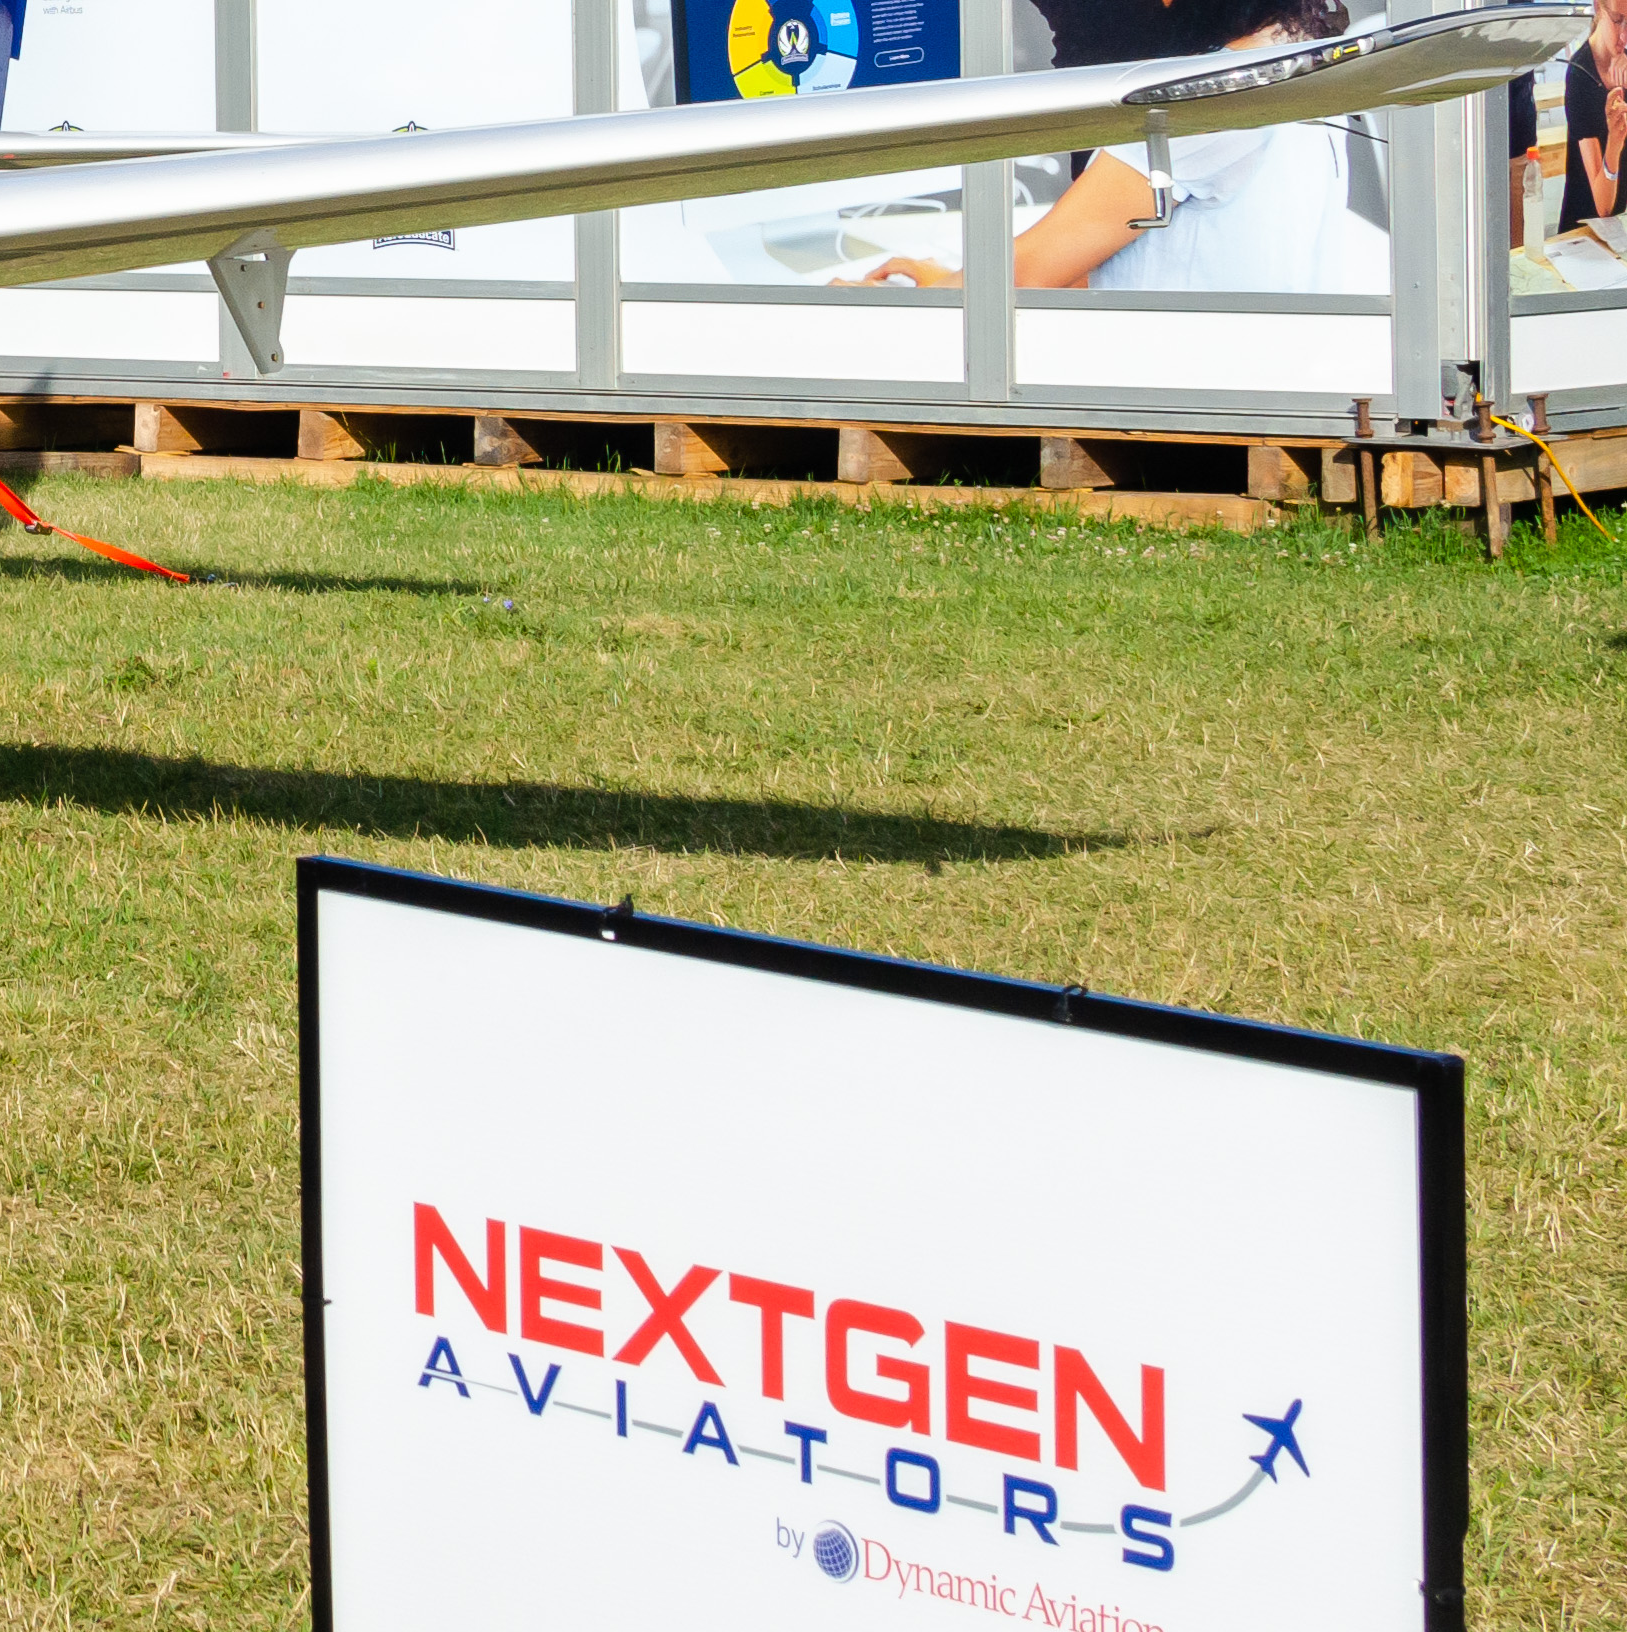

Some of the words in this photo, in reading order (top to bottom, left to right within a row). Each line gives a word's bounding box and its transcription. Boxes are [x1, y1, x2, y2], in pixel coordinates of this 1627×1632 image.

[413, 1200, 1168, 1492] NEXTGEN
[416, 1335, 1175, 1574] AVIATORS
[776, 1517, 805, 1558] by
[862, 1538, 1016, 1617] Dynamic
